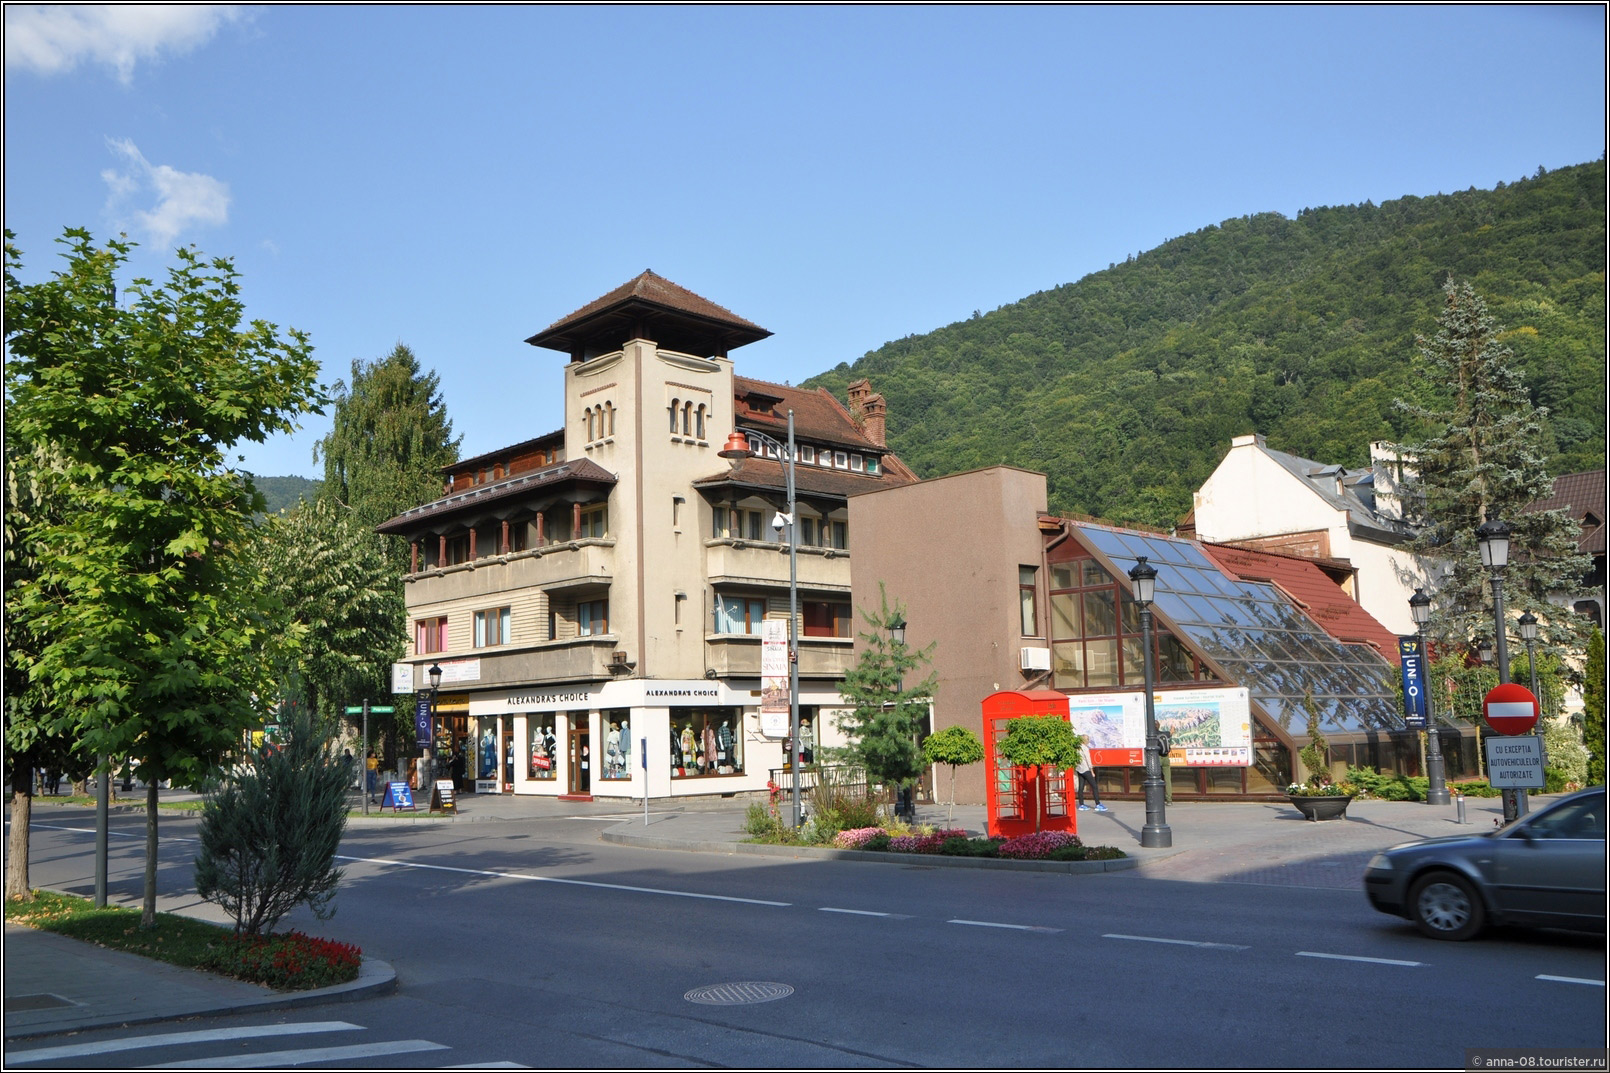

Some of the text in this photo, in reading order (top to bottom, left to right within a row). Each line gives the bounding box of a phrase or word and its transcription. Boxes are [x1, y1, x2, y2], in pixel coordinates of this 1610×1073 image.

[559, 692, 589, 702] CHOICE
[1495, 745, 1503, 754] CU
[1490, 757, 1540, 767] AUTOVEHICULELOR
[1499, 770, 1534, 780] AUTORIZATE
